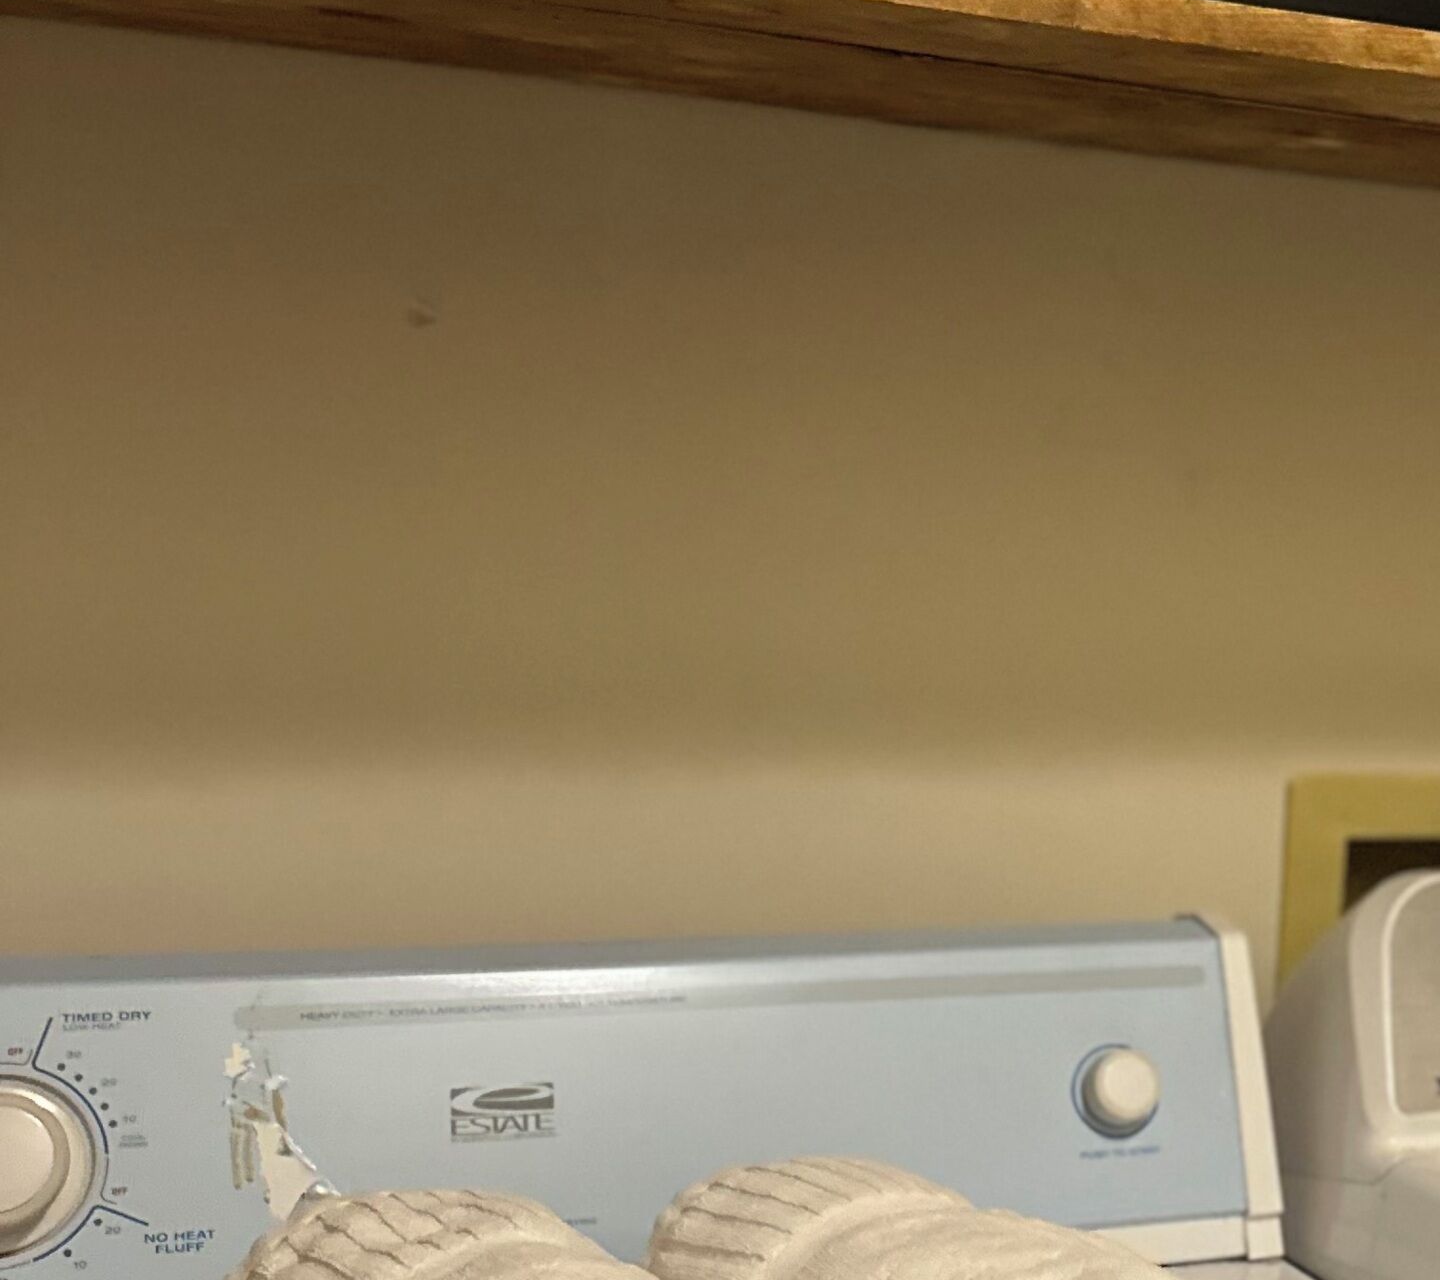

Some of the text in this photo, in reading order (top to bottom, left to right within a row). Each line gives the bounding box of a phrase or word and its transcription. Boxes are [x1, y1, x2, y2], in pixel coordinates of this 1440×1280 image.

[62, 1010, 151, 1023] TIMED DRY
[450, 1113, 555, 1136] ESTATE
[104, 1225, 121, 1236] 20
[144, 1229, 216, 1244] NO HEAT
[155, 1242, 205, 1255] FLUFF
[73, 1260, 87, 1271] 10
